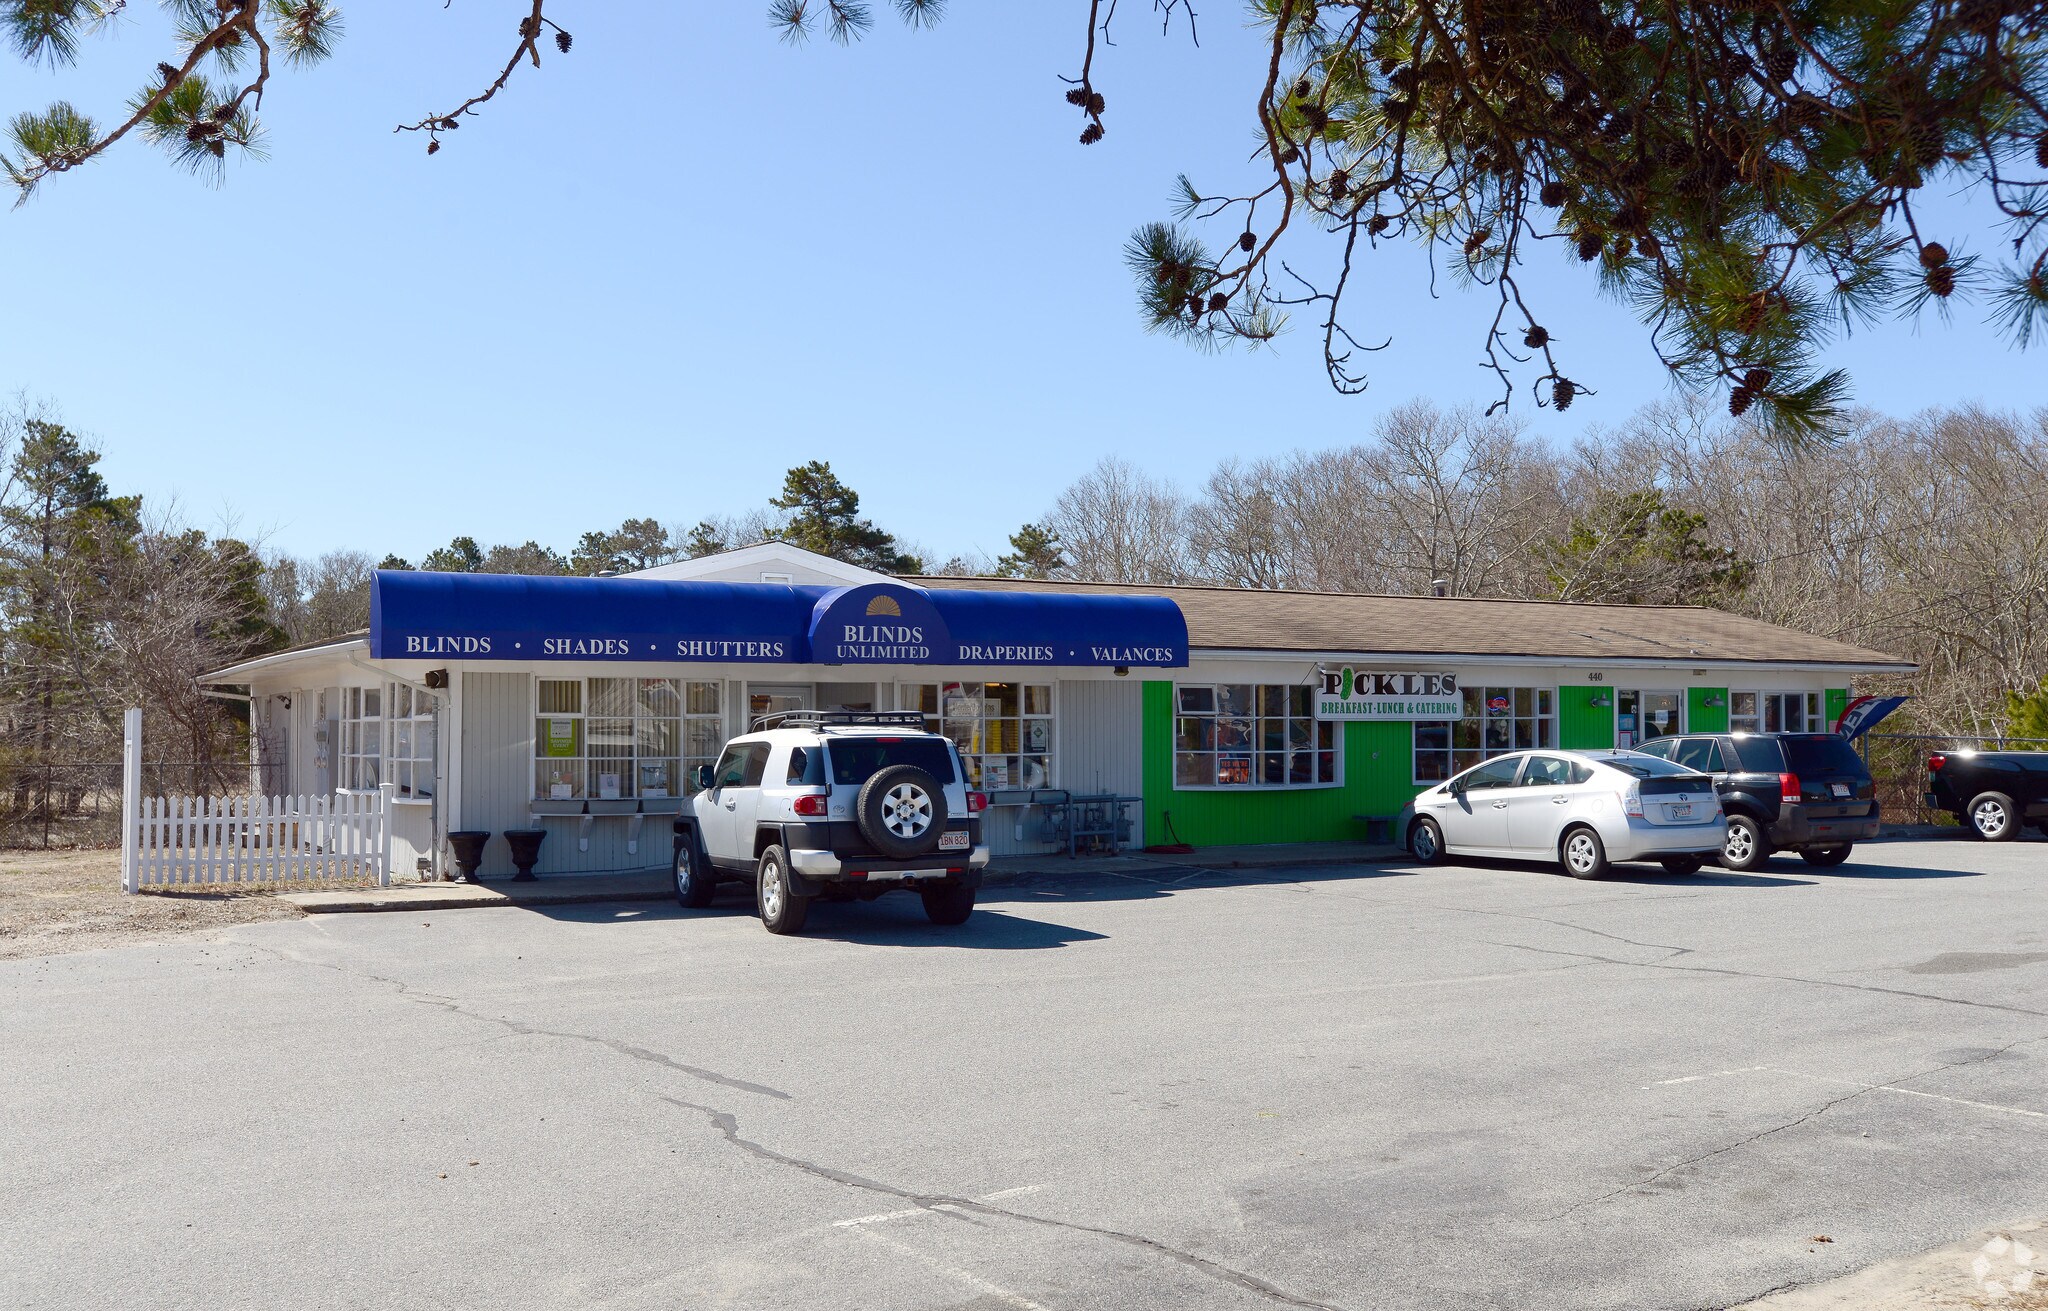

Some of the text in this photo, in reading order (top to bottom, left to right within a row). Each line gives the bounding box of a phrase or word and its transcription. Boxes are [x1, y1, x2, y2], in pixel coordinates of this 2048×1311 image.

[844, 625, 923, 644] BLINDS
[406, 636, 784, 658] BLINDS SHADES SHUTTERS
[836, 645, 930, 659] UNLIMITED
[959, 645, 1173, 662] DRAPERIES VALANCES
[1588, 672, 1602, 681] 440
[1321, 702, 1457, 714] BREAKFAST LUNCH & CATERING
[1219, 767, 1249, 783] OPEN
[954, 835, 968, 845] 820
